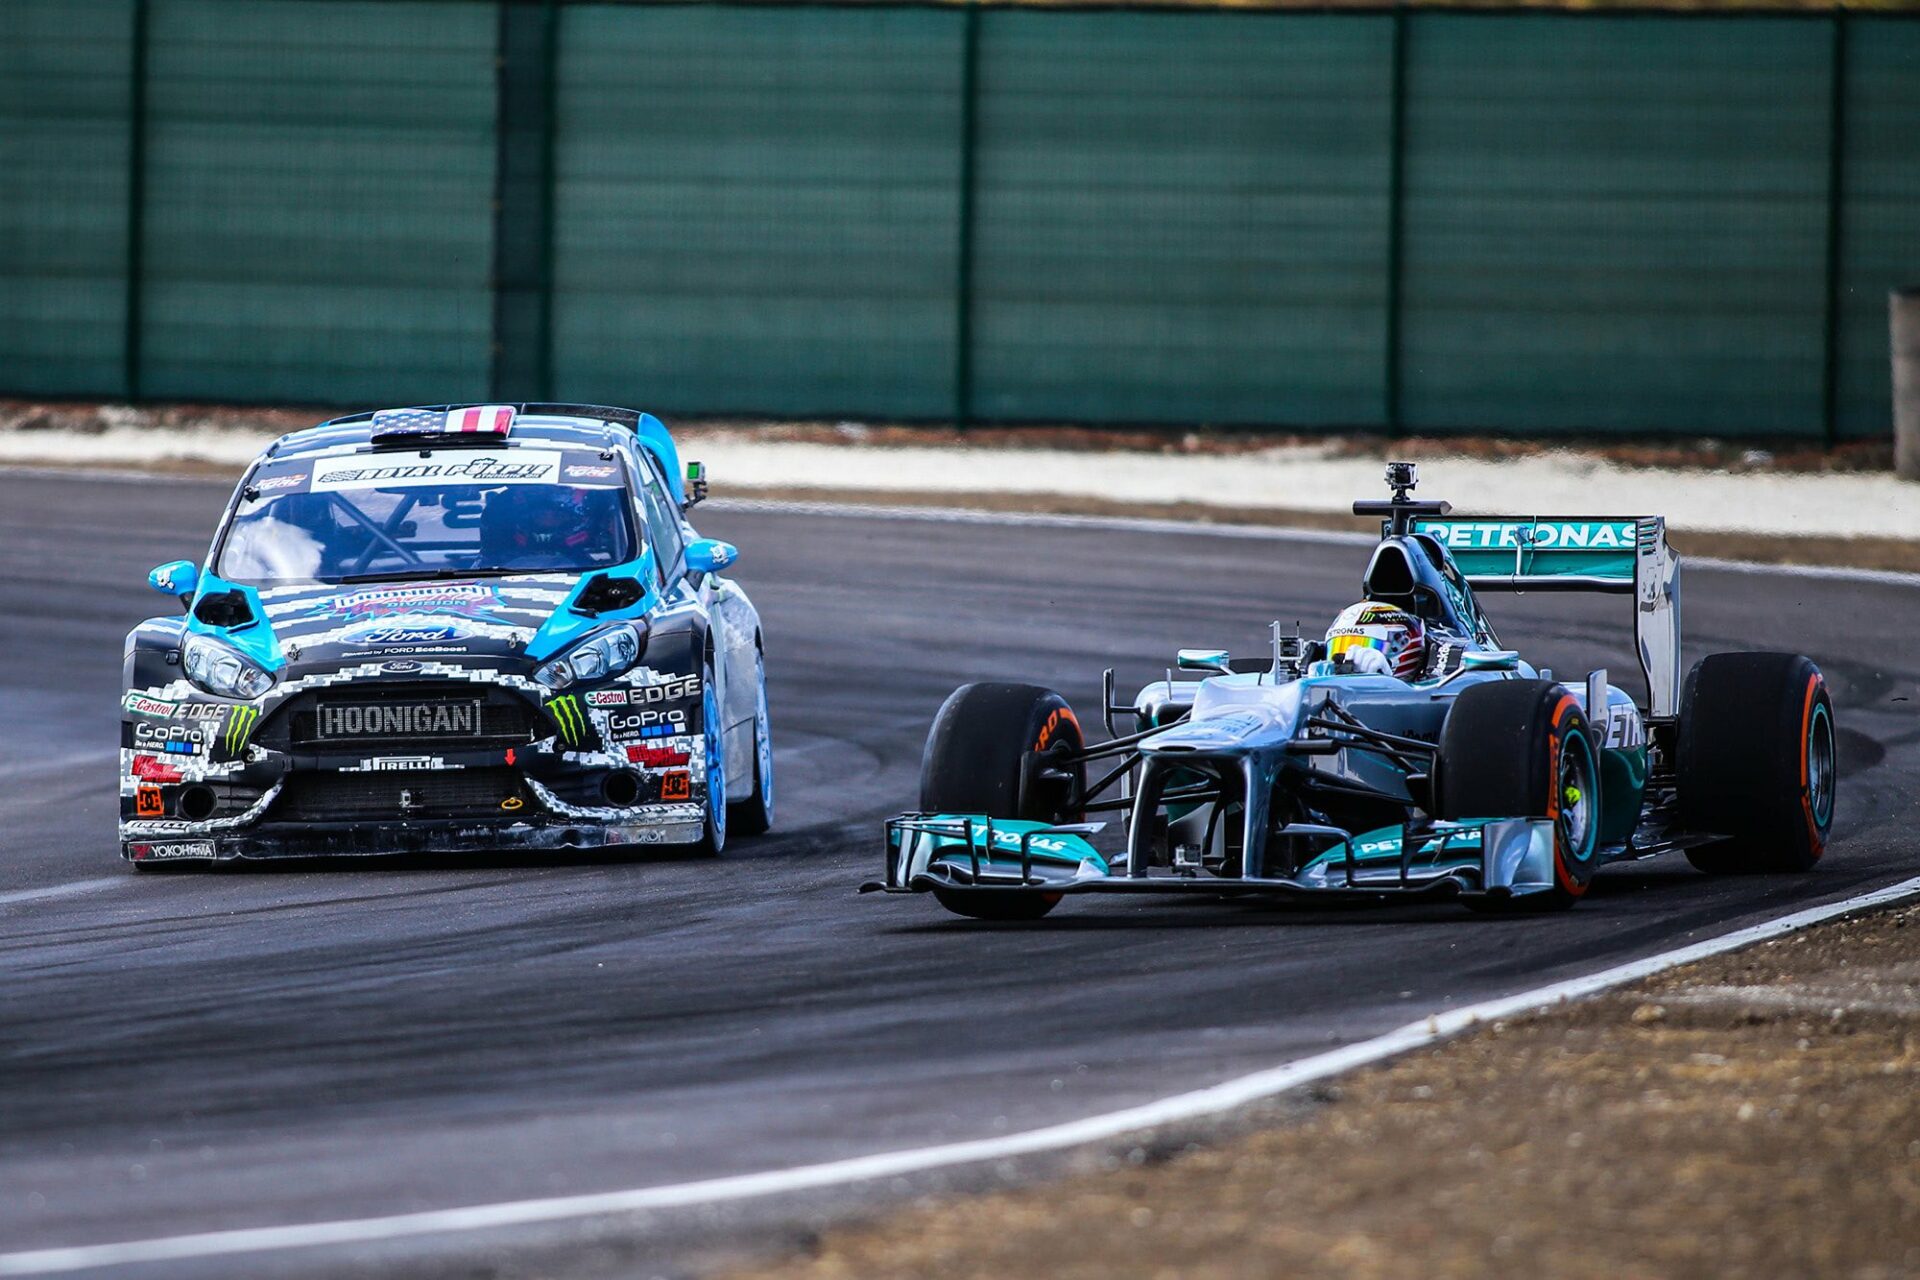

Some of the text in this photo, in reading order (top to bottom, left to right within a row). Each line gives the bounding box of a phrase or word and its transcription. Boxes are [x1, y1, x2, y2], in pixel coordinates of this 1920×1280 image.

[359, 458, 553, 481] ROYAL PURPLE
[365, 627, 446, 642] Ford
[389, 662, 413, 670] Ford
[596, 679, 701, 704] Castrol EDGE
[136, 699, 231, 720] Castrol EDGE
[610, 710, 685, 729] GoPro
[135, 722, 202, 742] GoPro
[372, 756, 431, 771] PIRELLI
[151, 844, 212, 857] YOKOHAMA
